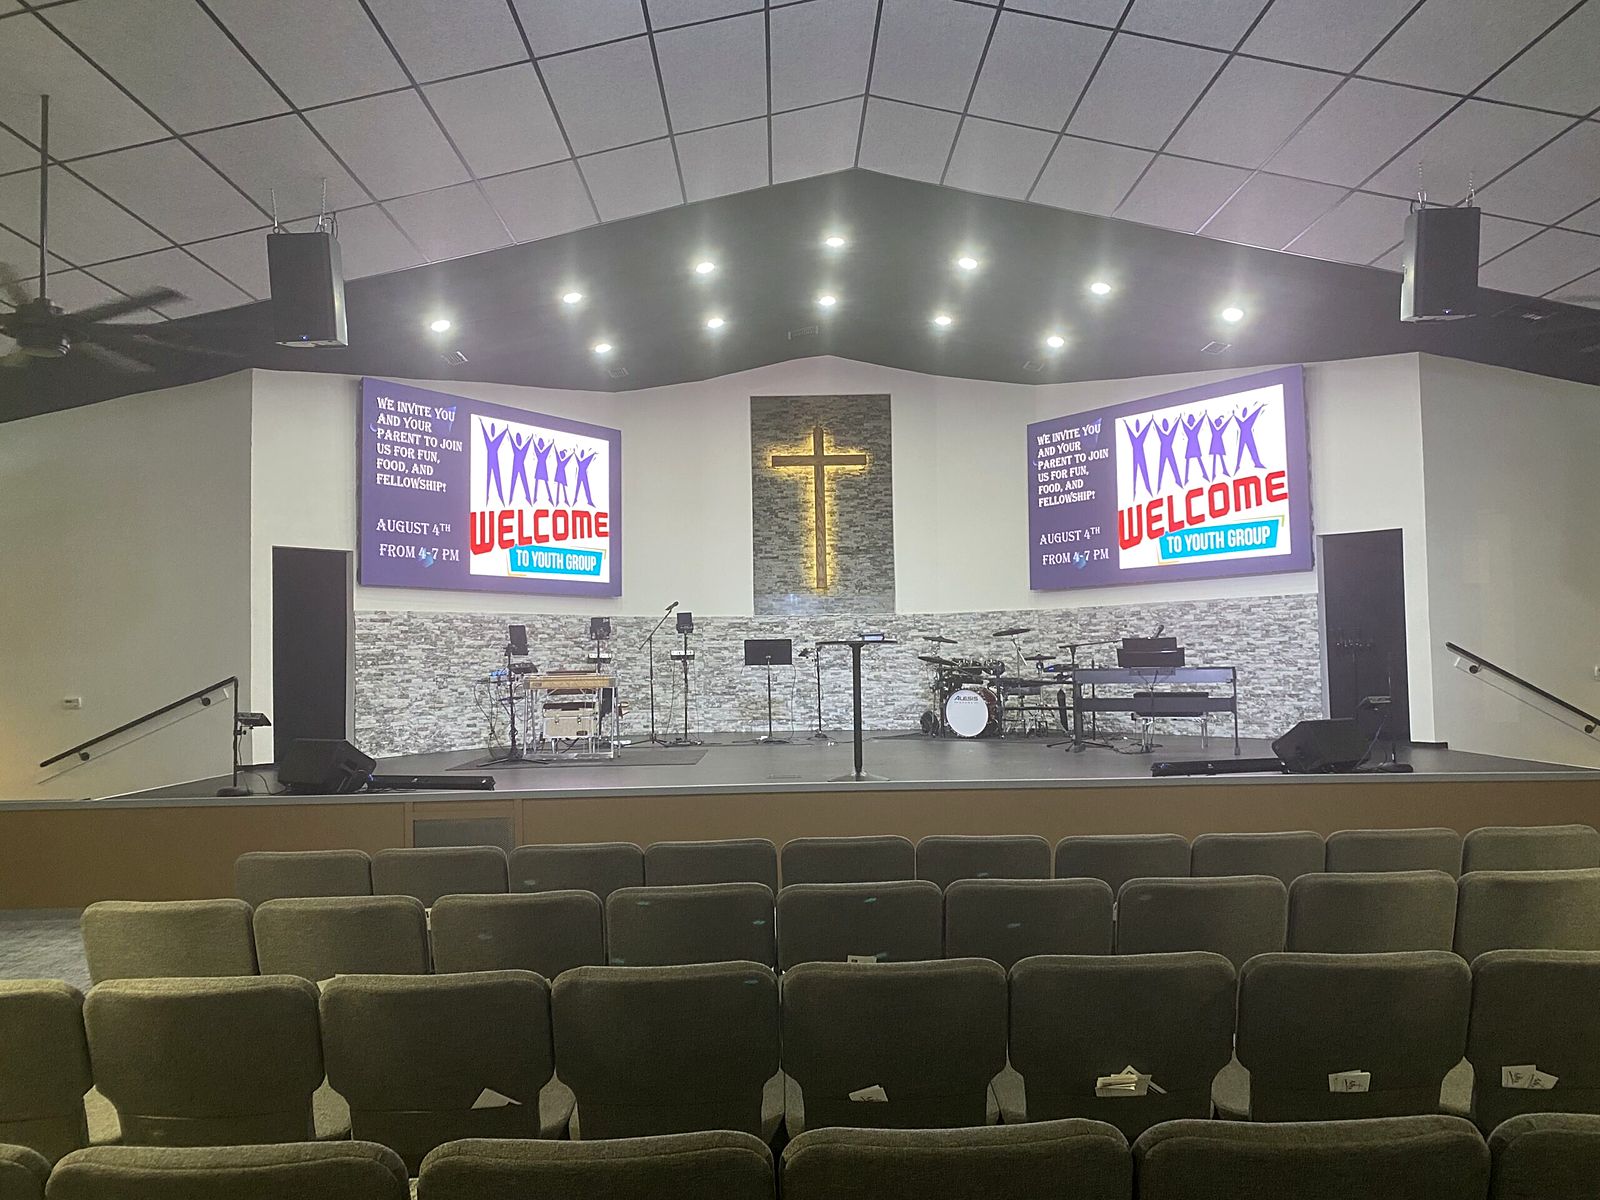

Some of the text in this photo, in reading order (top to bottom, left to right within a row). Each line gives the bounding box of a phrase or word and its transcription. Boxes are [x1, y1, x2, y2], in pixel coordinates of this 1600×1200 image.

[377, 397, 455, 421] WE INVITE YOU
[377, 413, 432, 432] AND YOUR
[377, 428, 462, 452] PARENT TO JOIN
[1037, 424, 1101, 445] WE INVITE YOU
[376, 443, 440, 464] US FOR FUN,
[1038, 441, 1081, 458] AND YOUR
[1038, 448, 1109, 470] PARENT TO JOIN
[376, 458, 433, 476] FOOD, AND
[1038, 466, 1089, 482] US FOR FUN,
[376, 473, 446, 492] FELLOWSHIP!
[1038, 479, 1084, 494] FOOD, AND
[1038, 490, 1095, 508] FELLOWSHIP!
[1118, 470, 1288, 550] WELCOME
[376, 518, 450, 536] AUGUST 4TH
[470, 509, 609, 556] WELCOME
[1040, 526, 1100, 545] AUGUST 4TH
[1166, 526, 1270, 554] TO YOUTH GROUP
[379, 544, 460, 562] FROM 4-7 PM
[516, 549, 597, 572] TO YOUTH GROUP
[1042, 548, 1109, 566] FROM 4-7 PM
